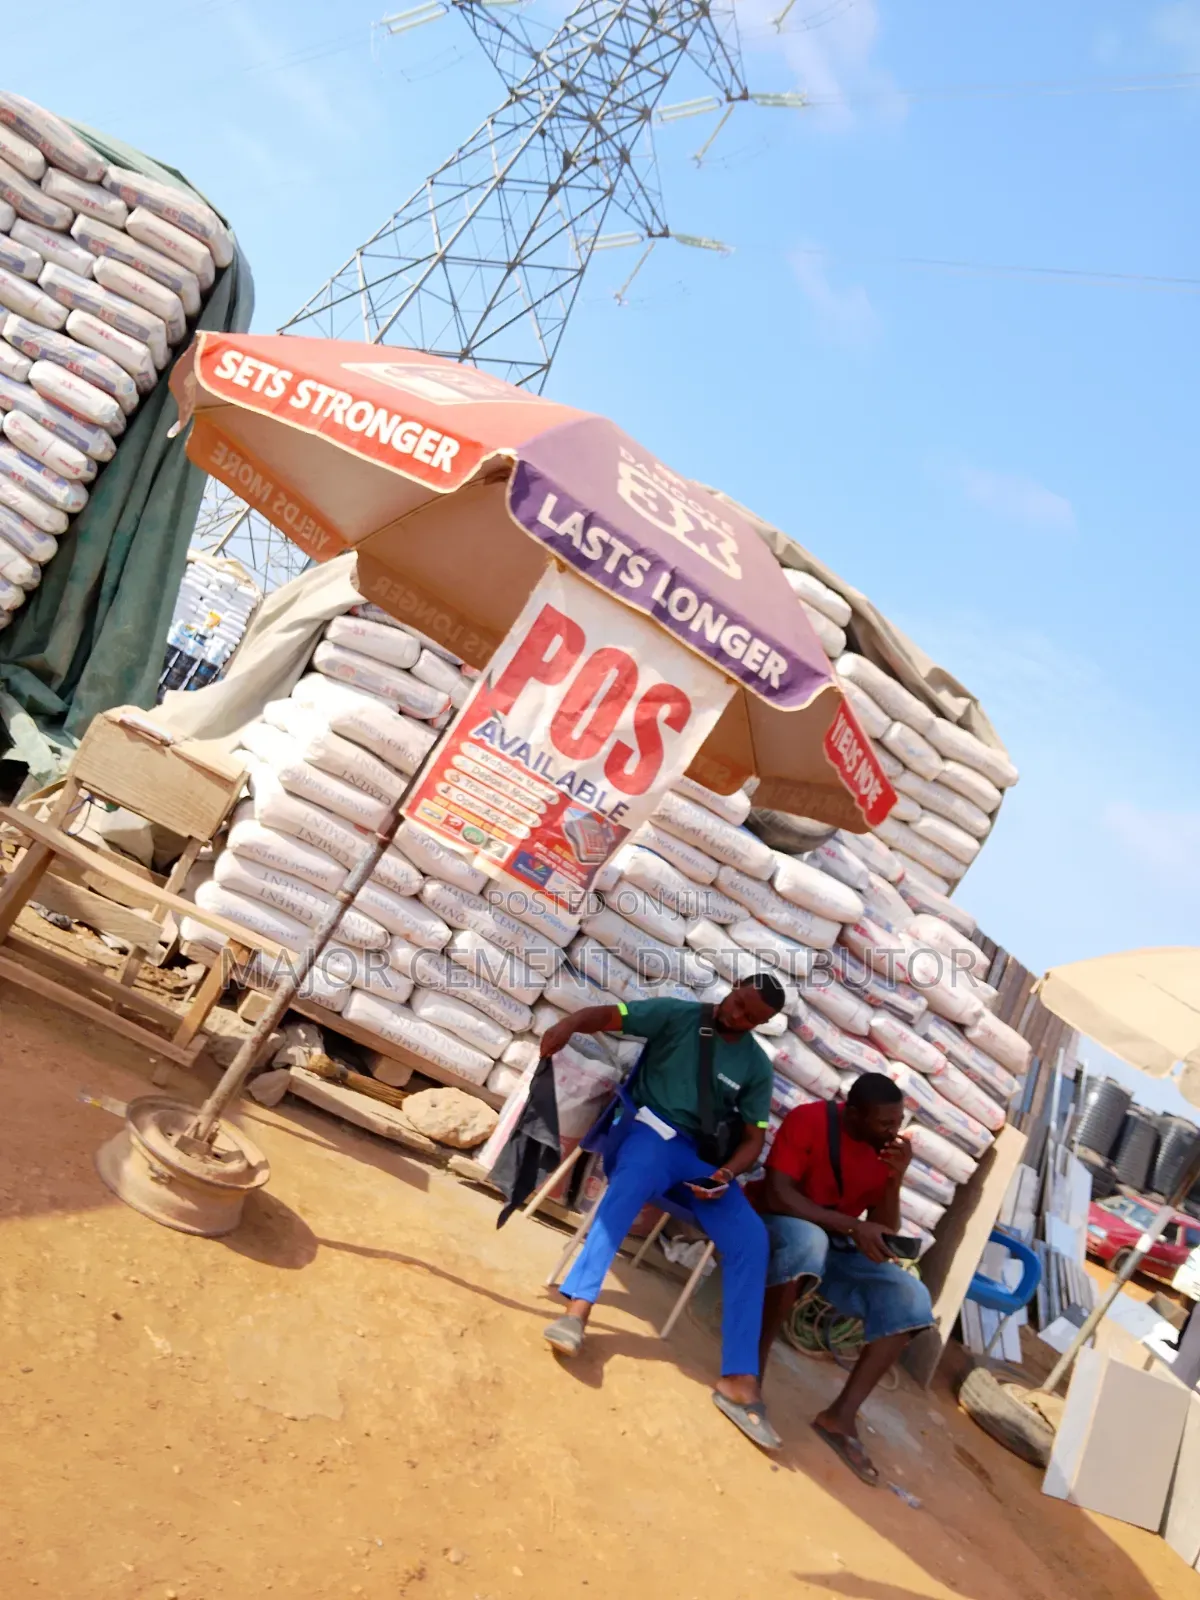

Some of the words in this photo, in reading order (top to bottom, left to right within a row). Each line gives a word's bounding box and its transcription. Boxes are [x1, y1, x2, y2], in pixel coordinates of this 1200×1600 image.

[215, 351, 291, 399] SETS
[289, 379, 460, 473] STRONGER
[617, 461, 742, 580] 3X
[537, 494, 650, 588] LASTS
[652, 572, 788, 689] LONGER
[499, 603, 691, 796] POS
[473, 720, 631, 823] AVAILABLE
[294, 825, 352, 861] CEMENT
[257, 886, 314, 921] CEMENT
[489, 912, 539, 945] CEMENT
